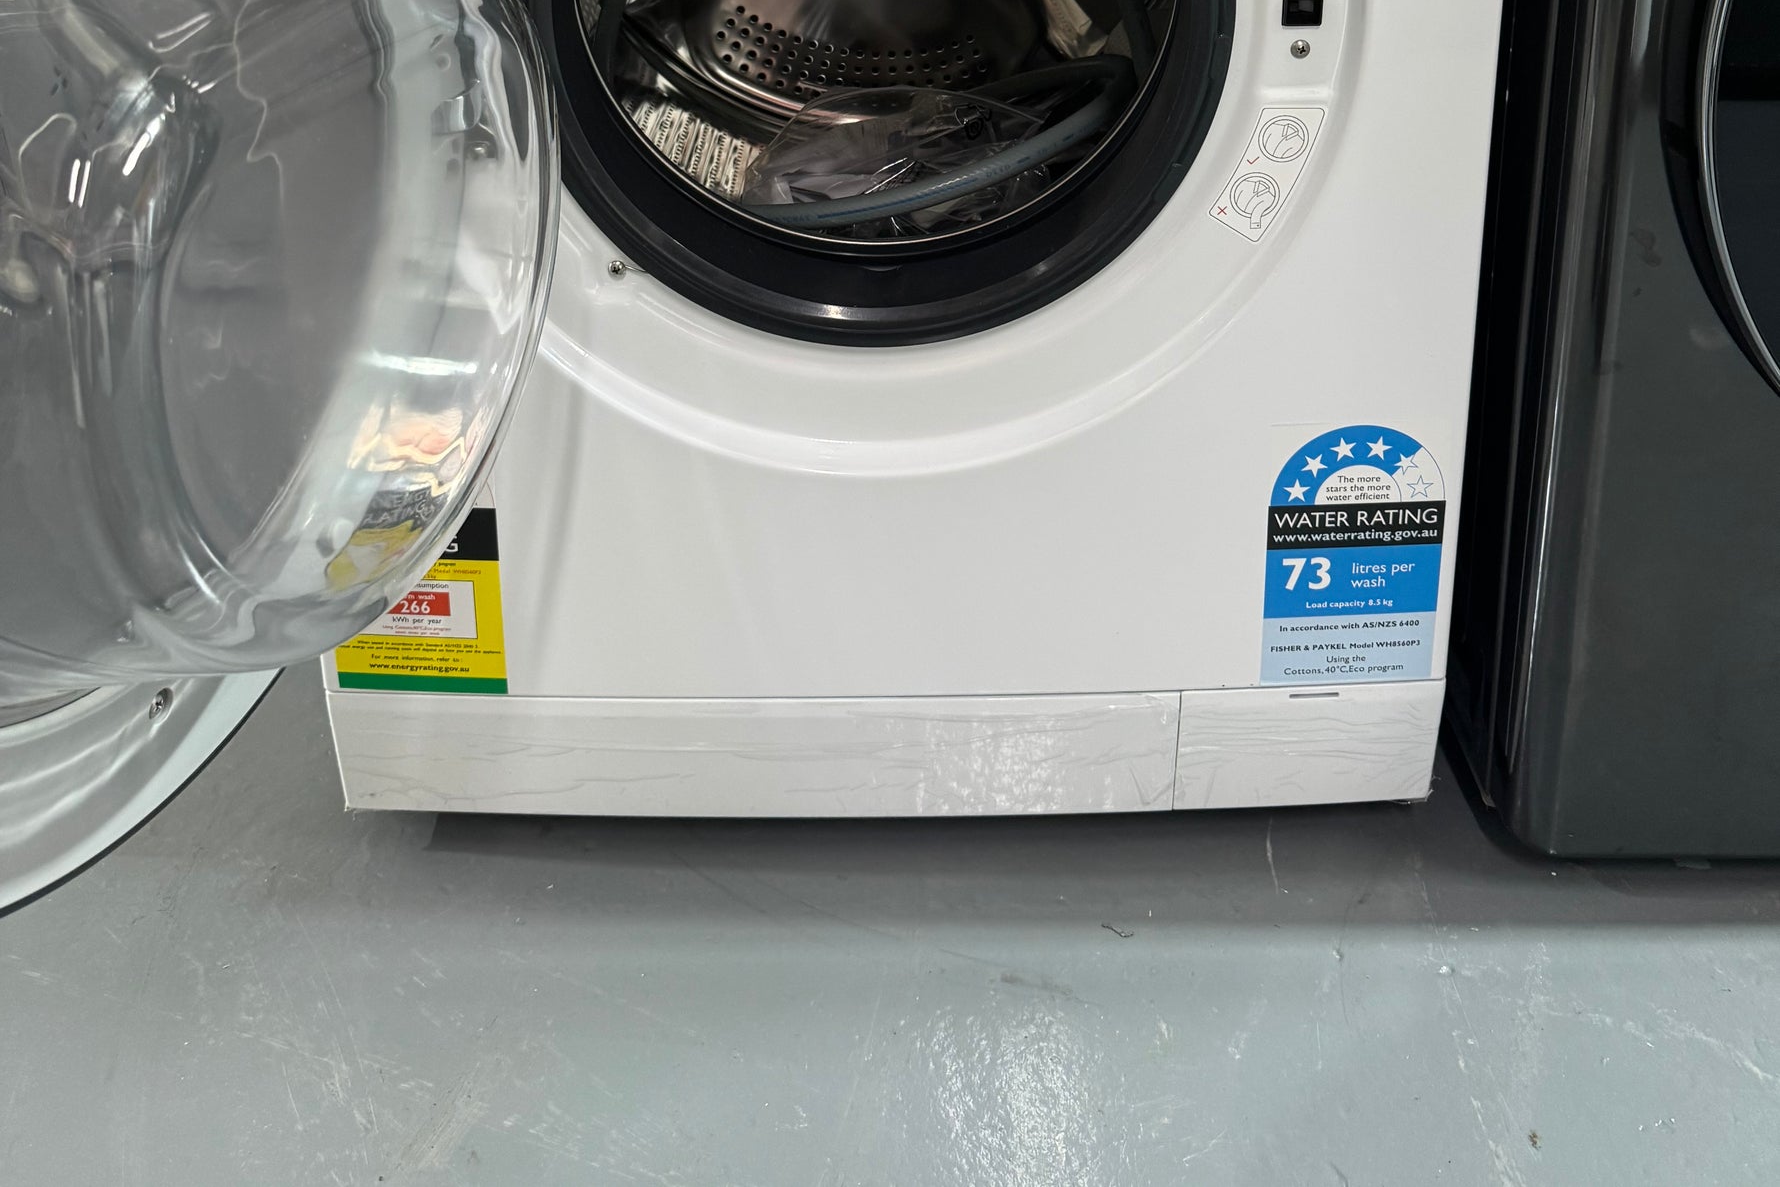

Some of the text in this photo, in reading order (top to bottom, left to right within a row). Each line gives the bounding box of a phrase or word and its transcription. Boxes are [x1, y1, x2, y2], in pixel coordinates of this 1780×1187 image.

[1354, 492, 1389, 500] efficient
[1275, 508, 1438, 528] WATER RATING
[1273, 528, 1437, 542] www.waterrating.gov.au
[1282, 557, 1331, 591] 73
[1352, 563, 1415, 575] litres per
[1351, 576, 1385, 588] wash
[400, 601, 430, 613] 266
[1329, 601, 1365, 609] capacity
[1290, 624, 1339, 632] accordance
[1326, 656, 1350, 664] Using
[370, 663, 469, 672] www.energyrating.gov.au
[1368, 664, 1403, 672] program
